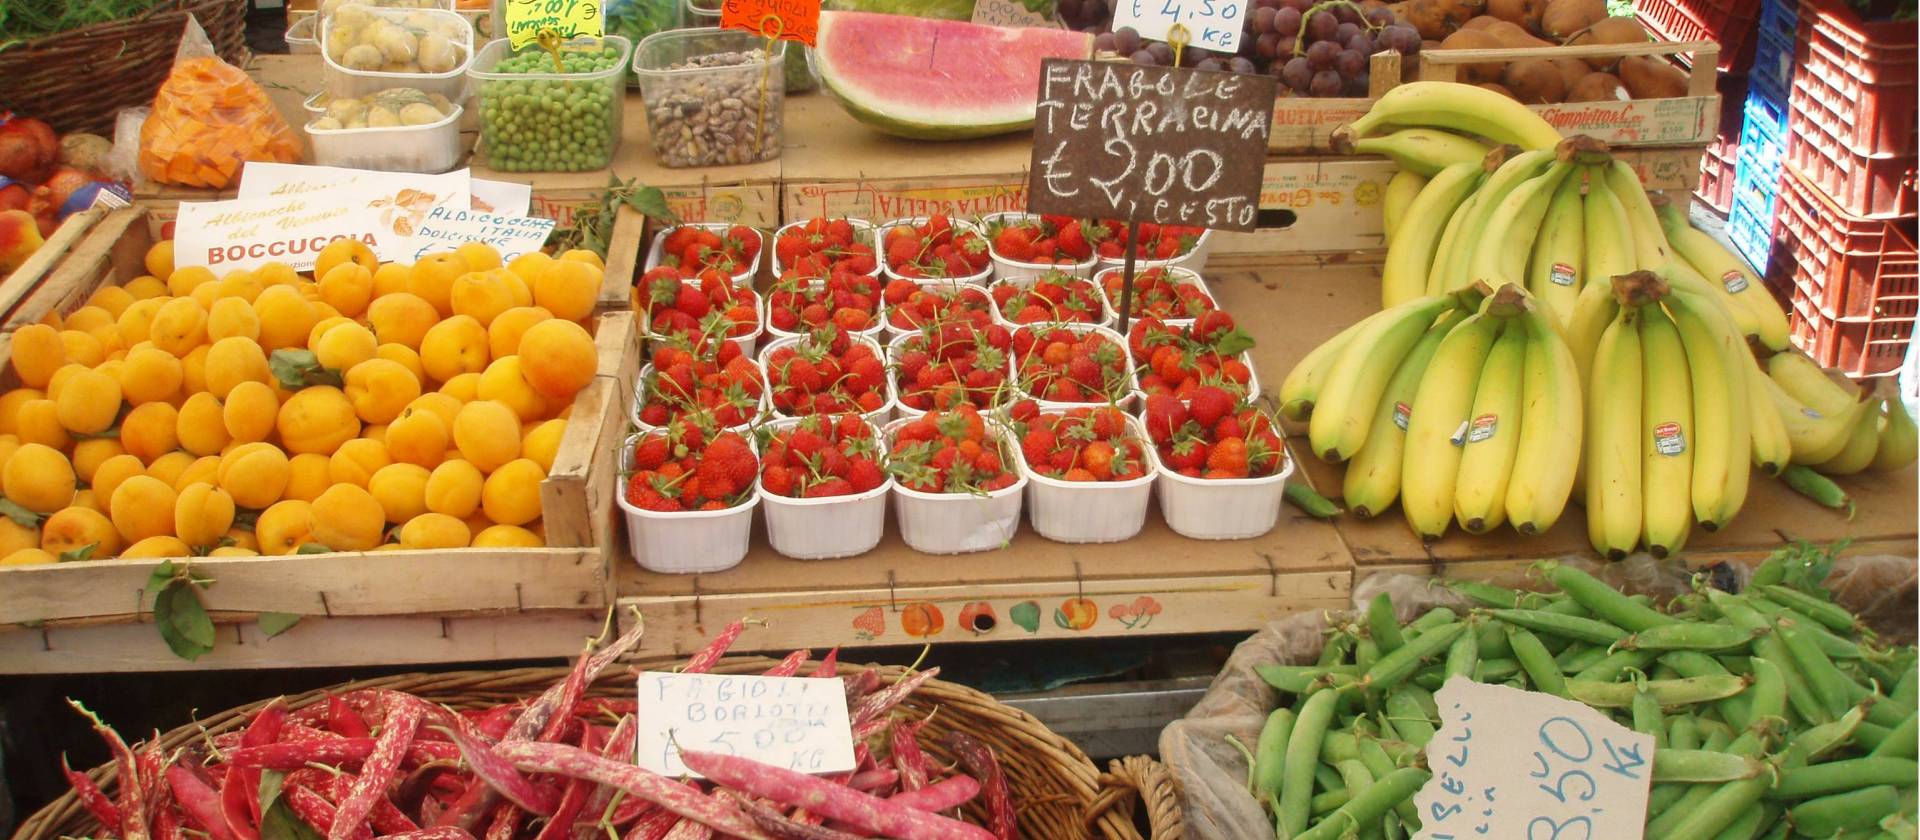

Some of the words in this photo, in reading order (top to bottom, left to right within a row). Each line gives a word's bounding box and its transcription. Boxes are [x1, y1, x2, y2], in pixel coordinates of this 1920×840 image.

[582, 3, 598, 20] €
[1160, 0, 1237, 23] 4,50
[1045, 65, 1241, 100] FRAGOLE
[1037, 100, 1268, 140] TERRACINA
[1040, 140, 1079, 197] €
[877, 193, 949, 218] SCELTA
[1153, 195, 1255, 226] CESTO
[207, 232, 379, 265] BOCCUCA
[480, 226, 543, 241] ITALIA
[1430, 701, 1473, 840] ISELLI
